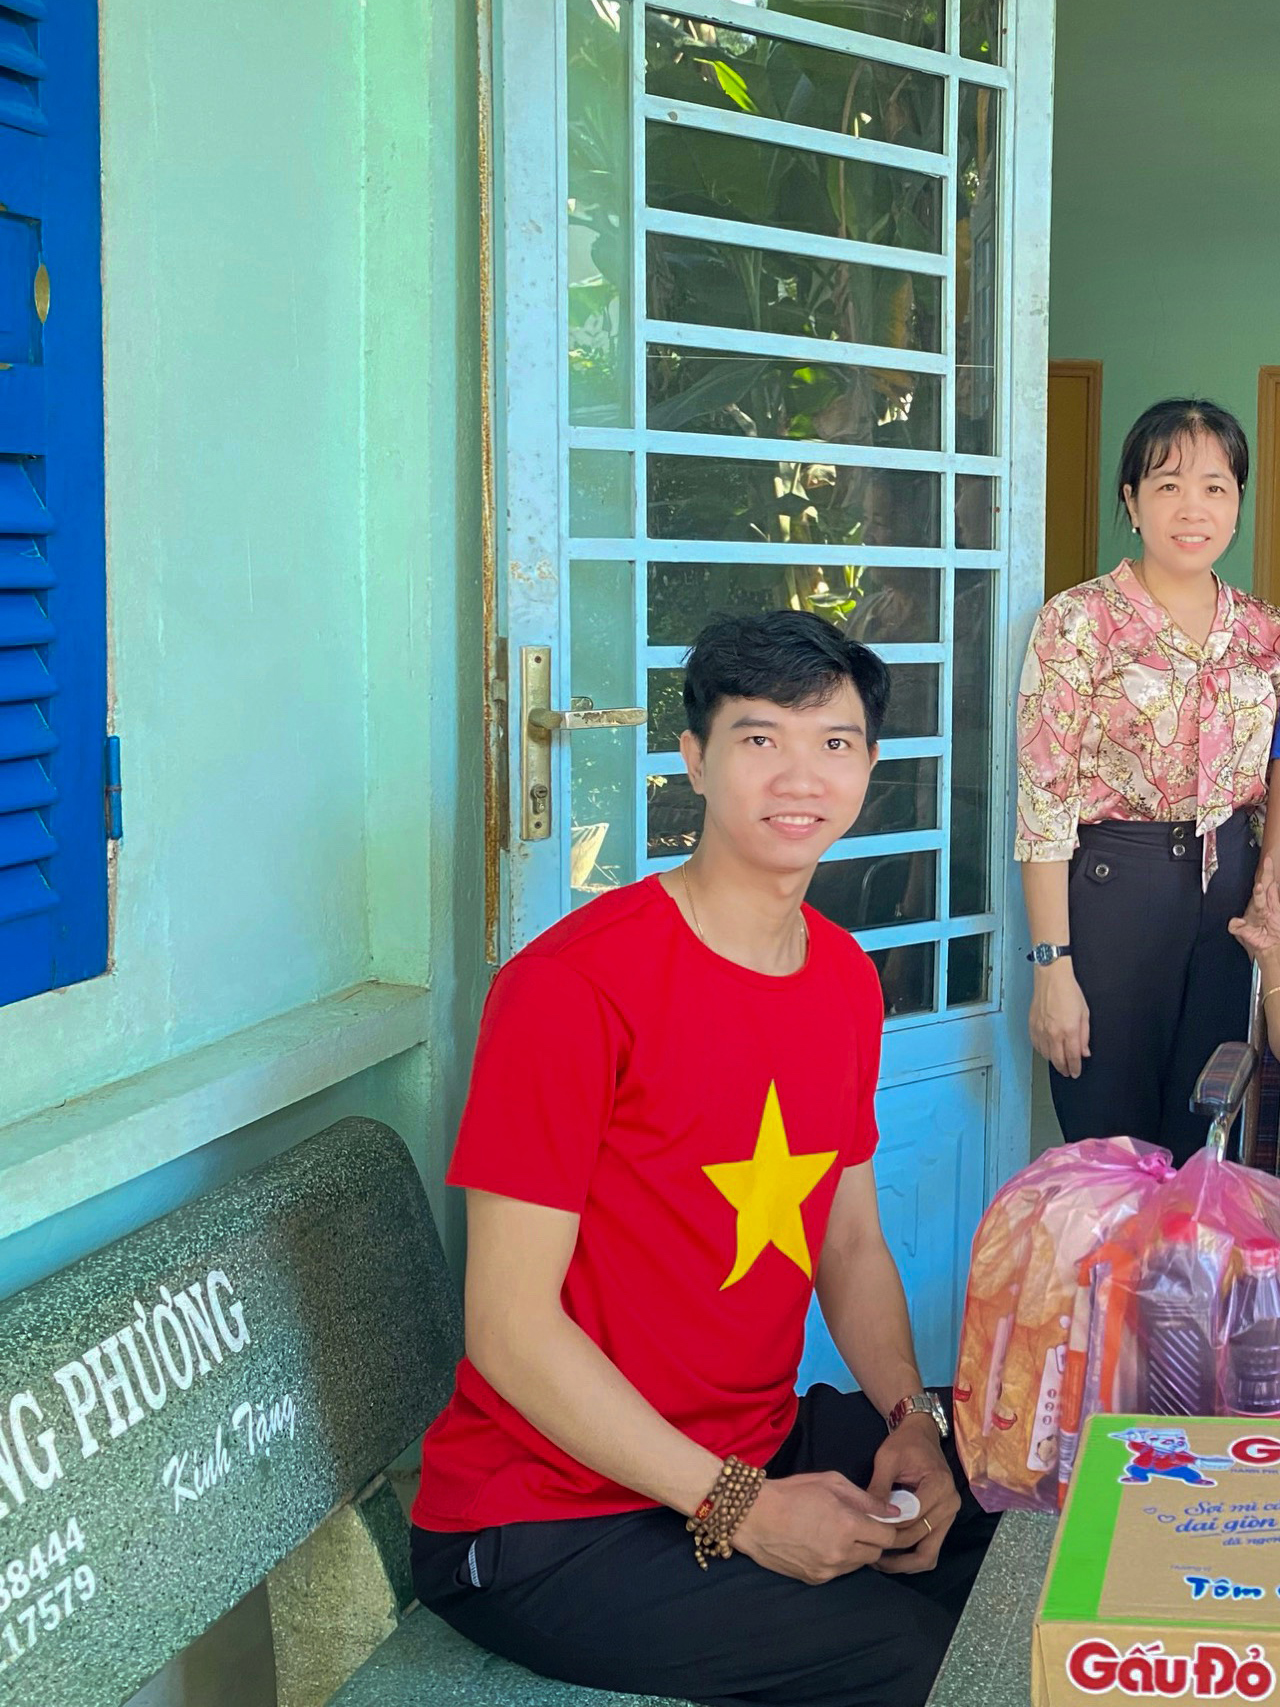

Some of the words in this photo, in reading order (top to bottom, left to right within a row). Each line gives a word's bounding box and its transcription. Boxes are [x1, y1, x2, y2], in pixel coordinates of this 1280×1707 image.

[1175, 1517, 1218, 1533] dai
[1185, 1576, 1263, 1600] Tôm
[1068, 1640, 1188, 1695] Gấu
[1193, 1645, 1273, 1698] Đỏ
